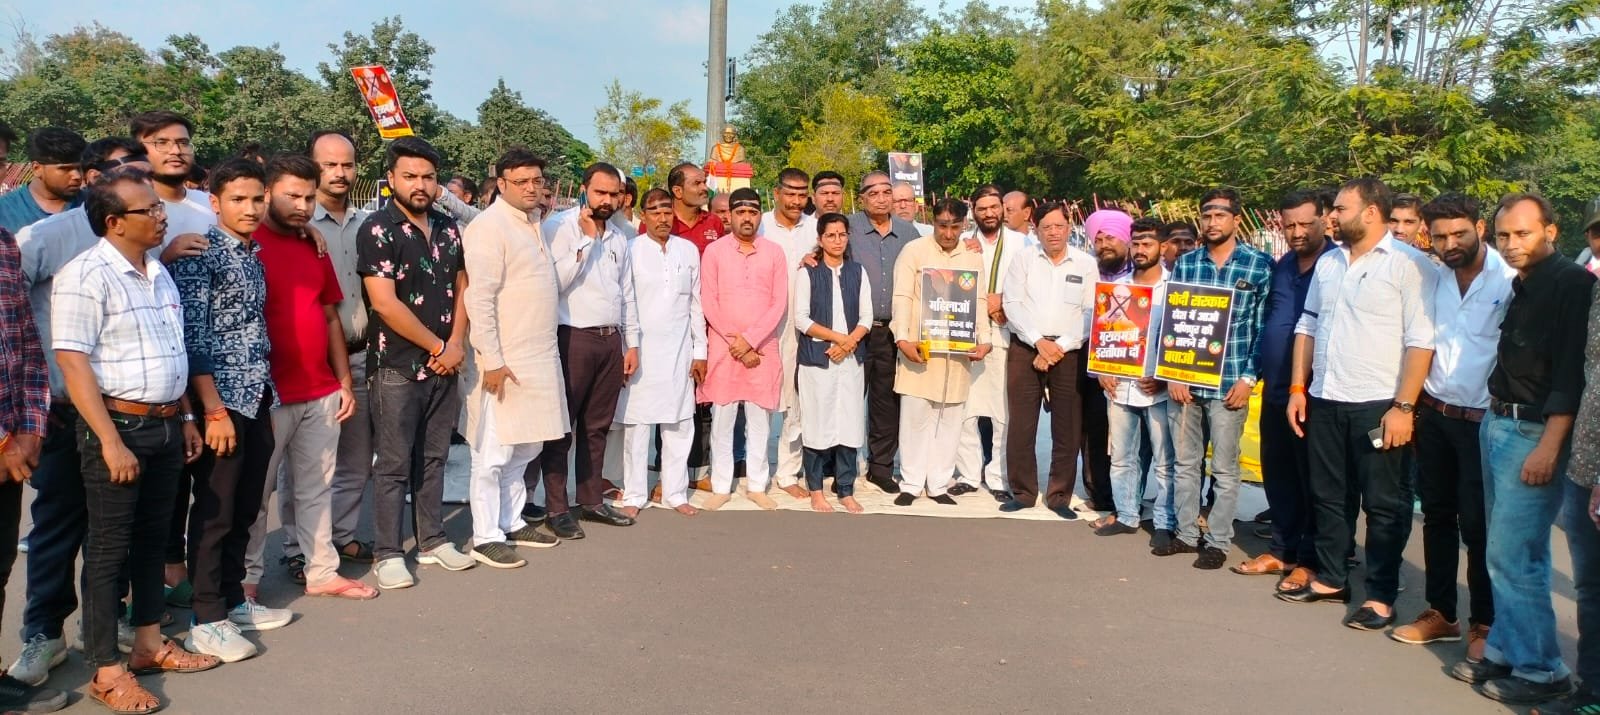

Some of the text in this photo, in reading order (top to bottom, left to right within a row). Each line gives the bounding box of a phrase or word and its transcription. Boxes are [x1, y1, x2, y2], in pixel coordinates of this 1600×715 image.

[928, 297, 971, 314] महिलाओं
[1168, 290, 1230, 308] मोदी सरकार
[1099, 327, 1140, 346] मुख्यमंत्री
